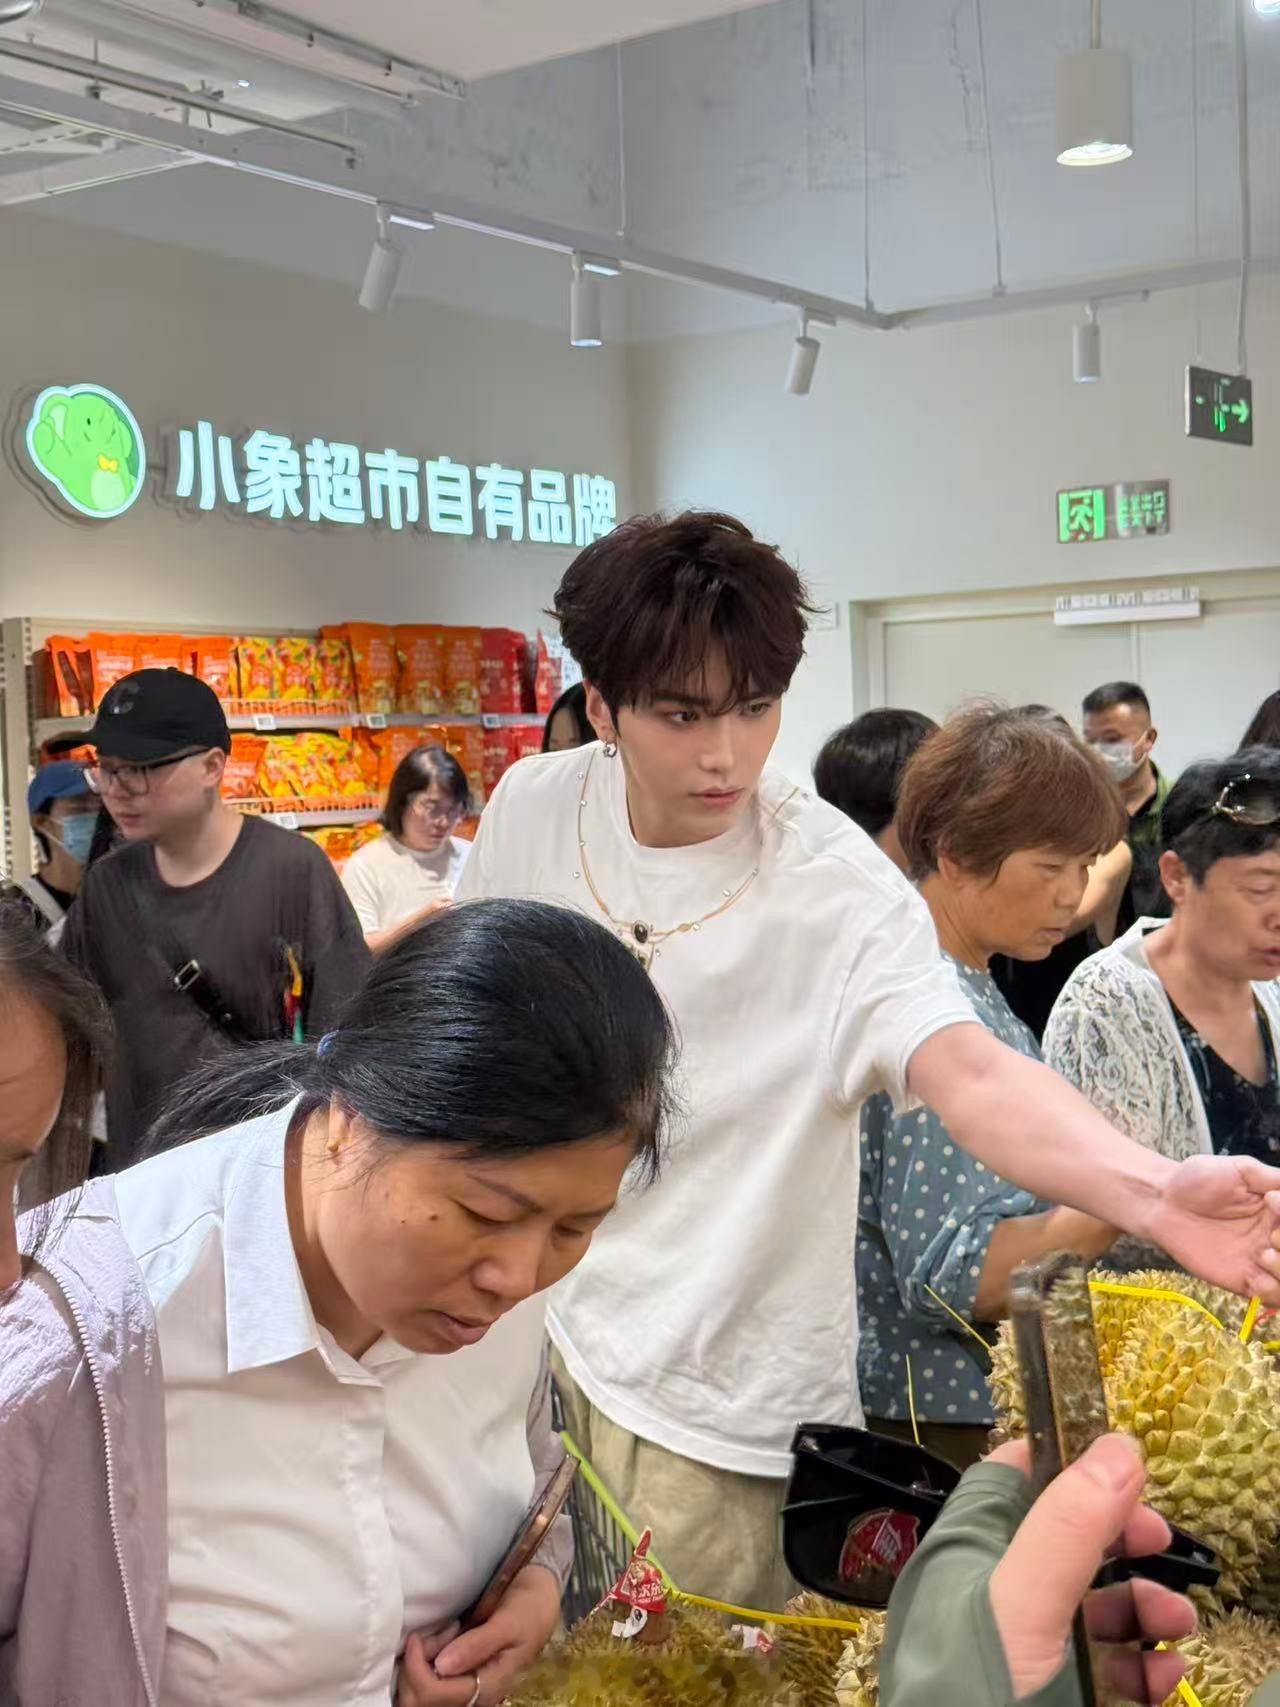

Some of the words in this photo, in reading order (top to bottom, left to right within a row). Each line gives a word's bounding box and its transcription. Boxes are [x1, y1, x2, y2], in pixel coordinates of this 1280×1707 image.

[175, 420, 617, 547] 小象超市自有品牌
